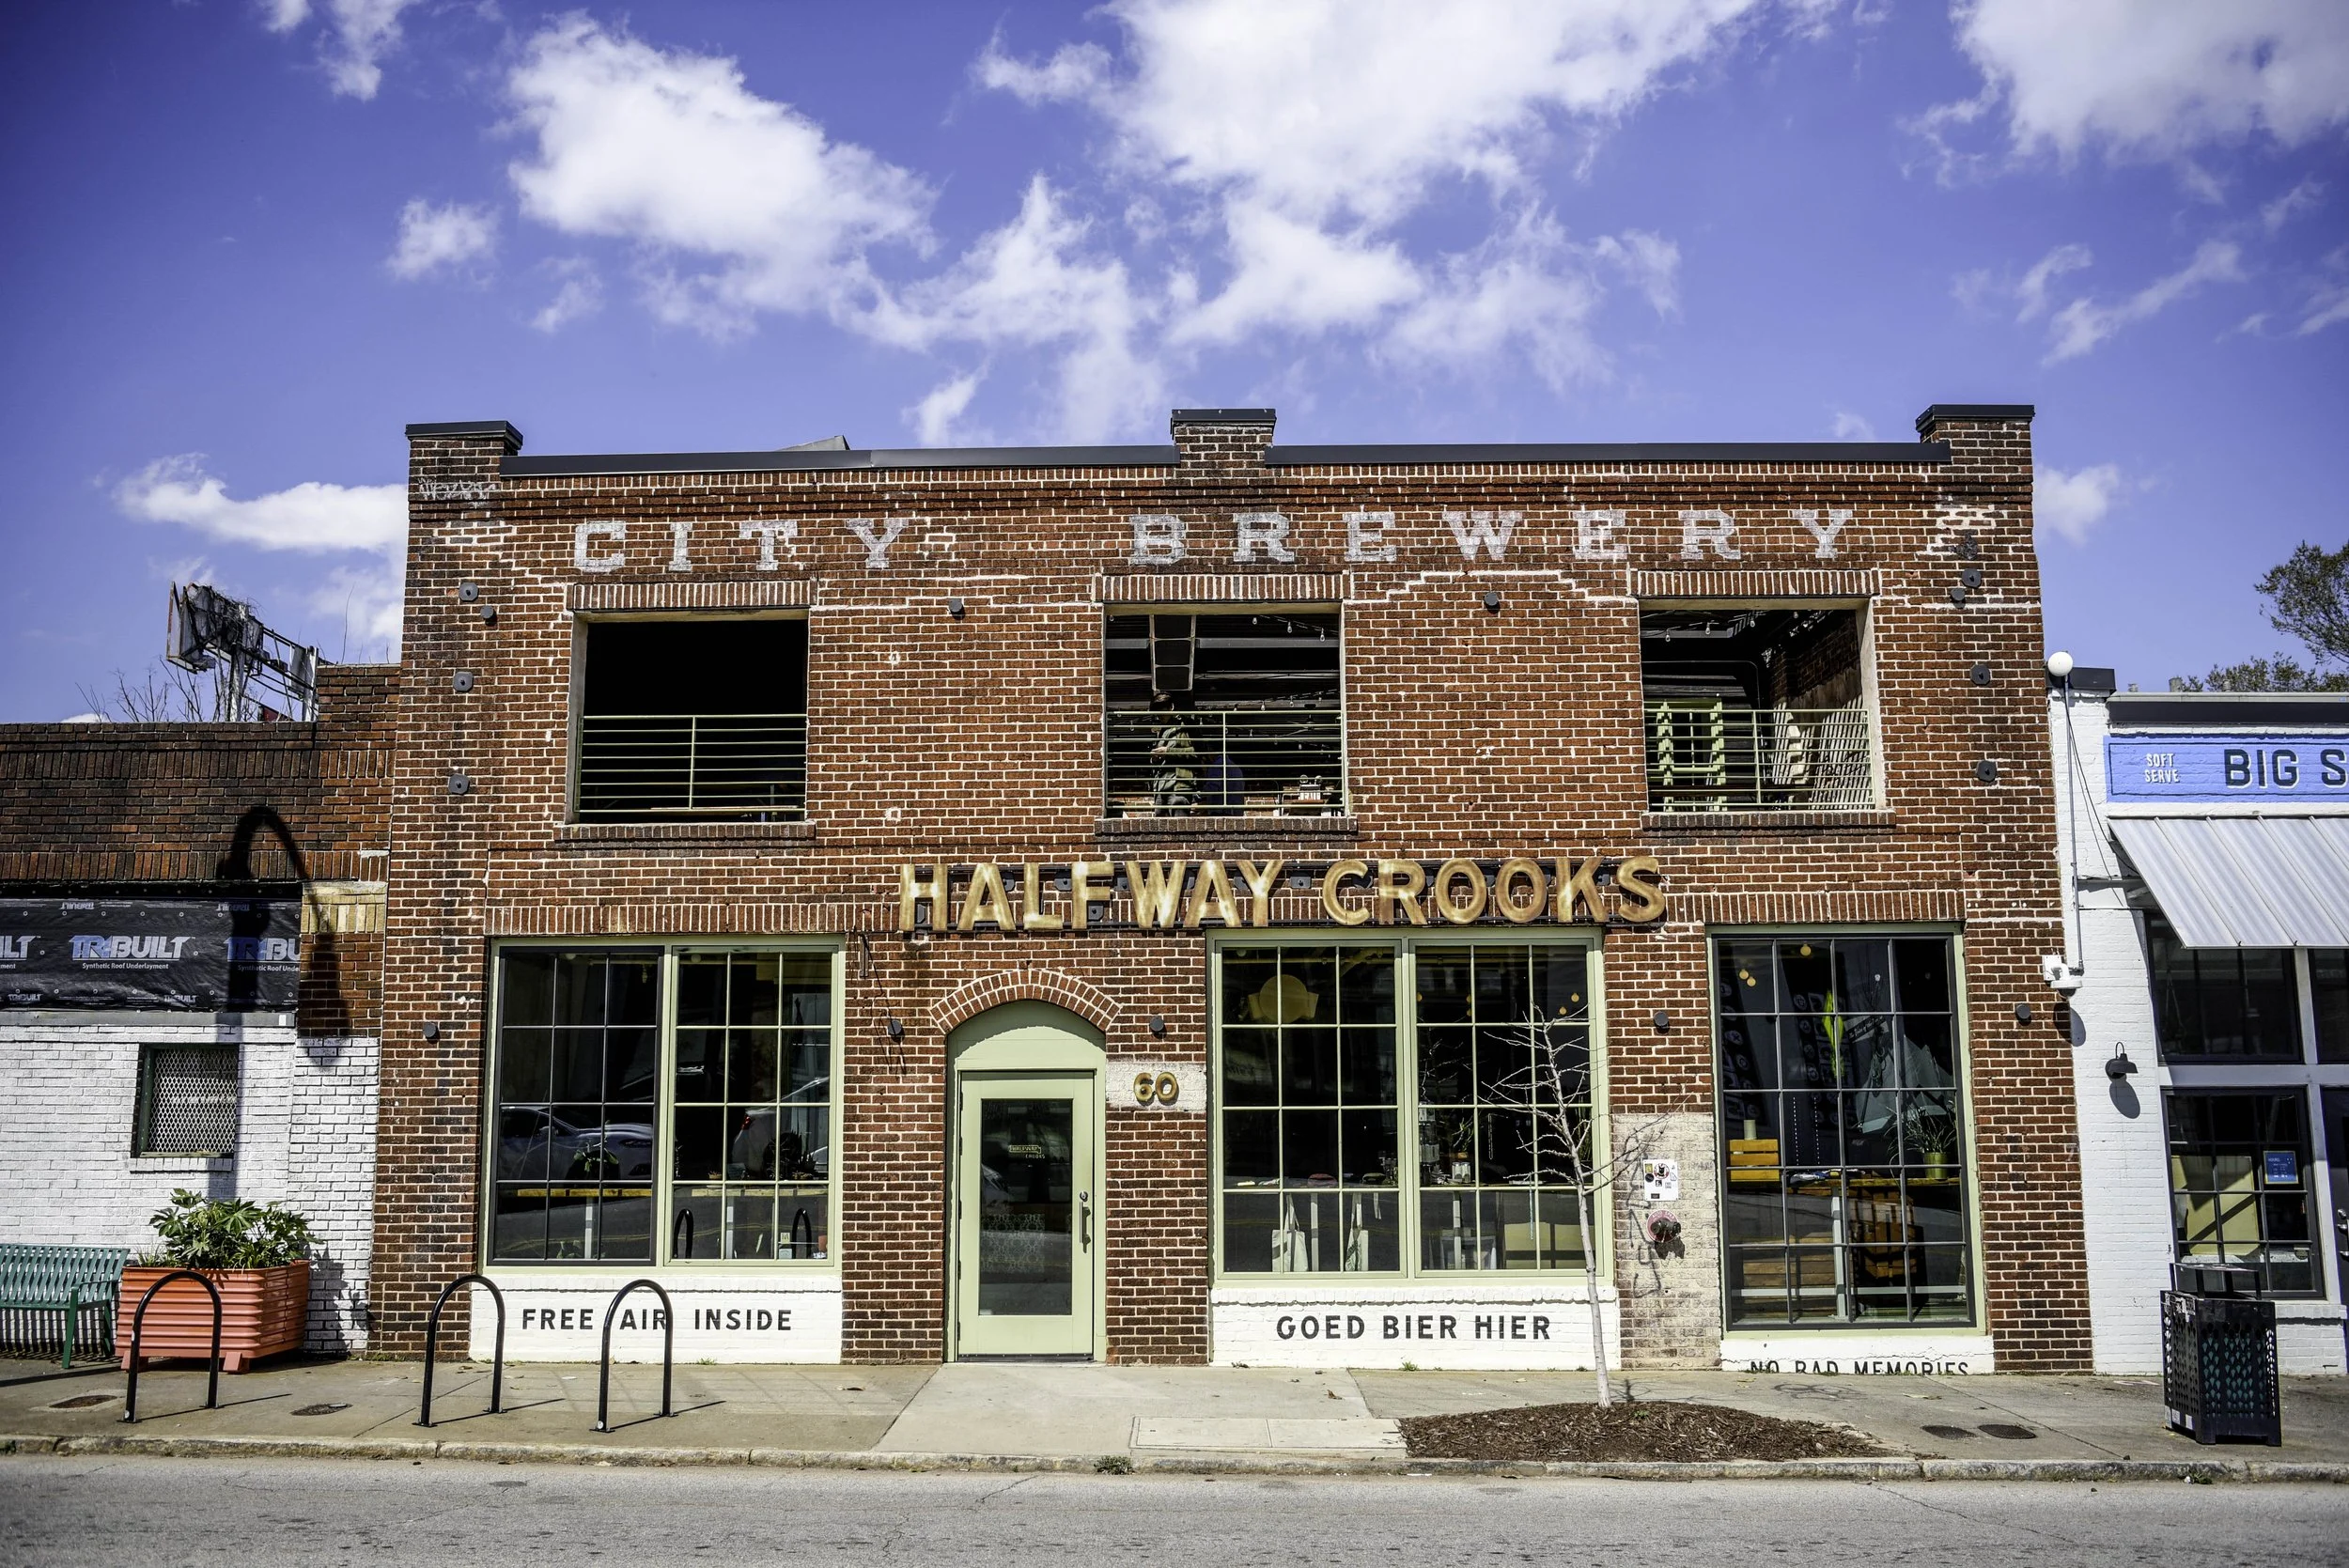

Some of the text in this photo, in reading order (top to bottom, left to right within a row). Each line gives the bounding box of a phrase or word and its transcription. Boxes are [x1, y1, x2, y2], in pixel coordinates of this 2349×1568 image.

[574, 509, 1853, 573] CITY BREWERY
[2146, 753, 2175, 768] SOFT
[2224, 749, 2300, 789] BIG
[2144, 768, 2181, 783] SERVE
[898, 856, 1666, 931] HALFWAY CROOKS
[1133, 1072, 1178, 1103] 60
[521, 1308, 792, 1331] FREE AIR INSIDE
[1276, 1314, 1550, 1340] GOED BIER HIER
[1750, 1360, 1969, 1375] NO BAD MEMORIES
